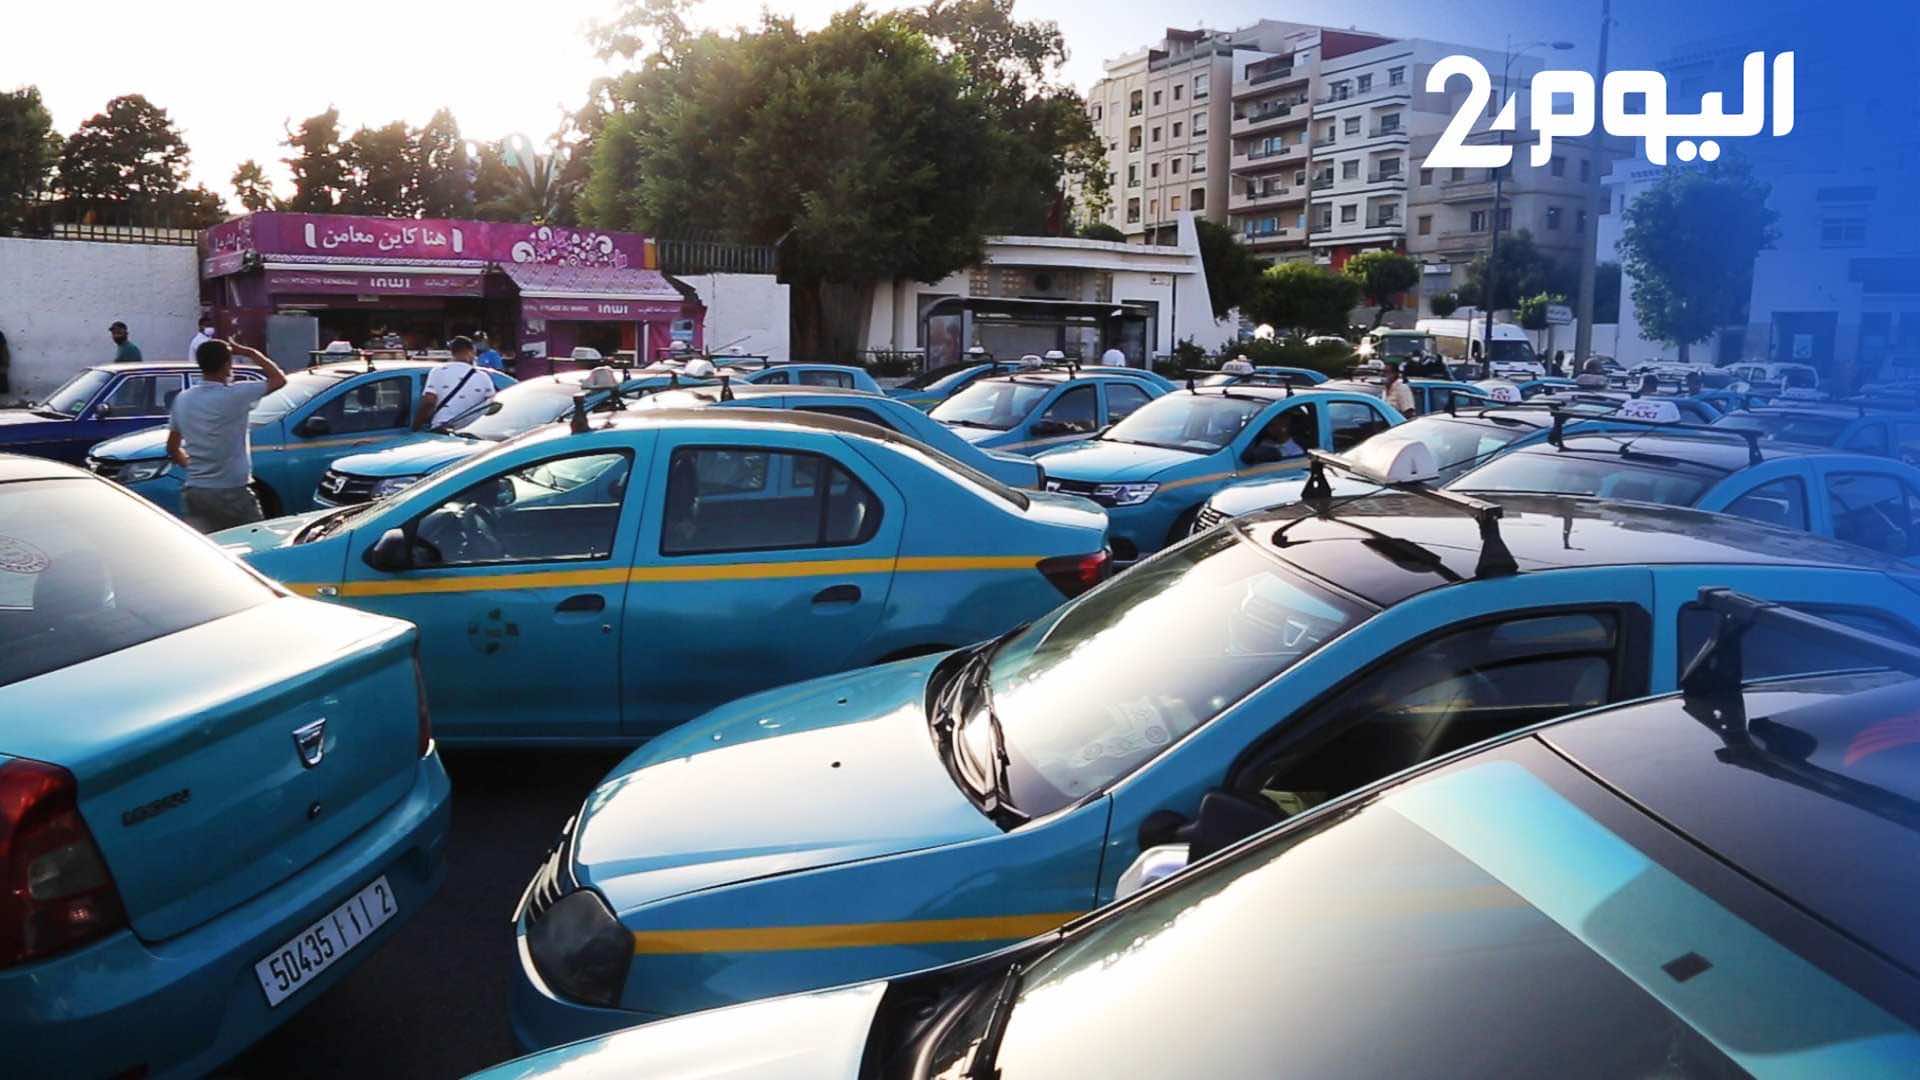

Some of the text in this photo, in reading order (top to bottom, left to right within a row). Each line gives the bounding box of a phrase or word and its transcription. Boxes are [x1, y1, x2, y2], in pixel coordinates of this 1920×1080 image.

[322, 225, 447, 250] هنا كاين معامن
[1624, 409, 1657, 419] TAXI
[269, 926, 334, 991] 50435
[375, 884, 392, 914] 2
